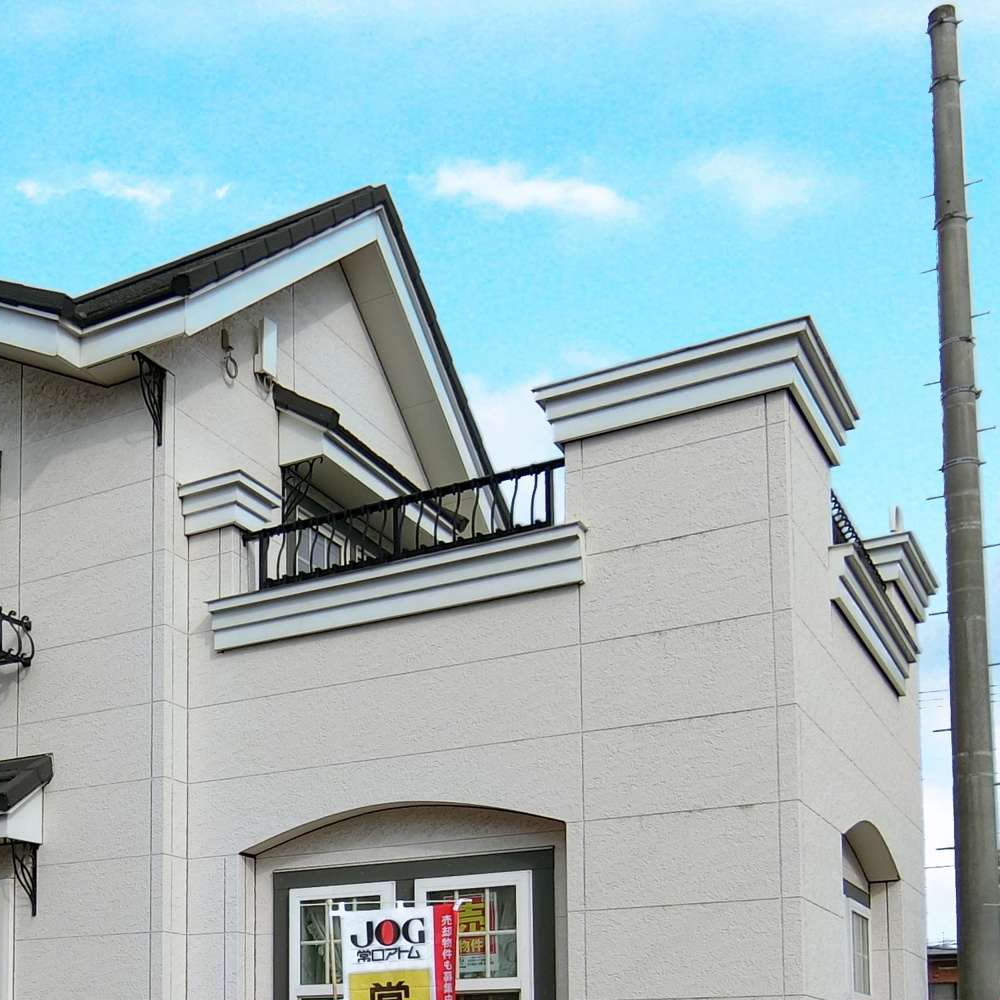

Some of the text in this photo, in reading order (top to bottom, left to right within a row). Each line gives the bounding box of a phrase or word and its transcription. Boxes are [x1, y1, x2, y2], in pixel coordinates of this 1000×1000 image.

[350, 918, 425, 948] JOG
[356, 946, 421, 963] 常口アトム
